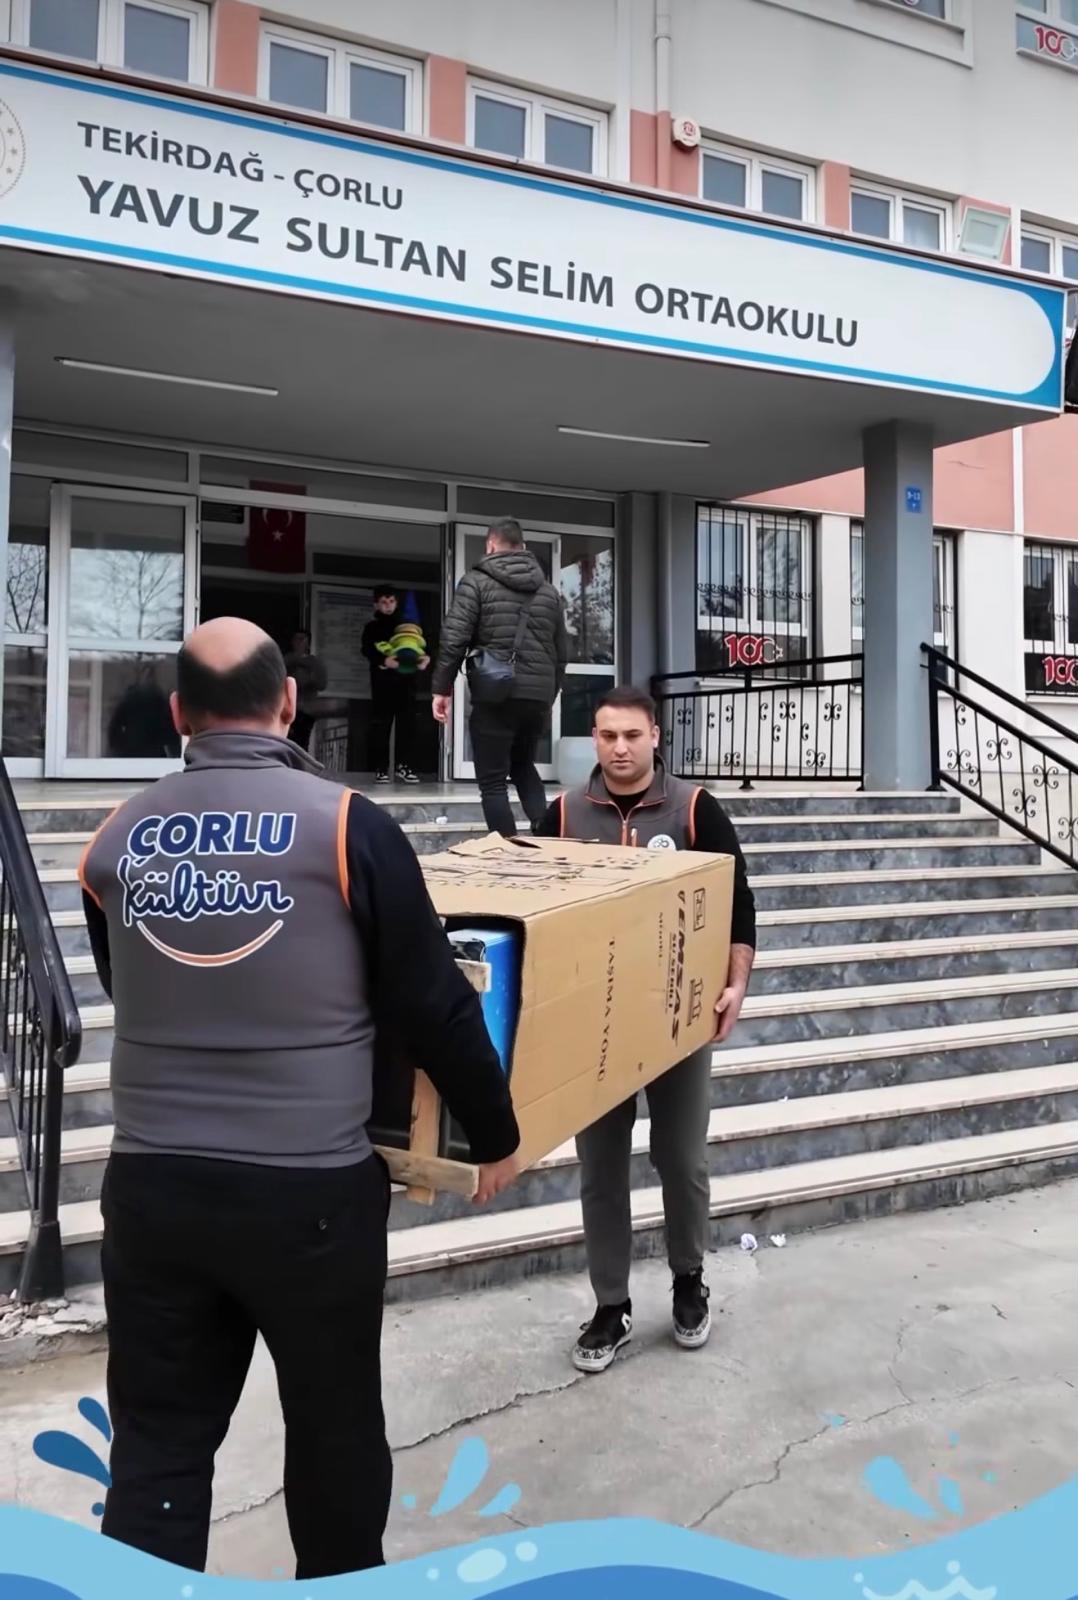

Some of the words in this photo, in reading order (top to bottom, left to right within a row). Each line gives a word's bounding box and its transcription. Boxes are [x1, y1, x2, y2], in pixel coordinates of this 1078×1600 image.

[77, 122, 264, 182] TEKİRDAĞ
[293, 168, 403, 210] ÇORLU
[77, 175, 260, 244] YAVUZ
[286, 217, 466, 282] SULTAN
[490, 256, 614, 308] SELİM
[635, 283, 858, 347] ORTAOKULU
[127, 811, 297, 867] ÇORLU
